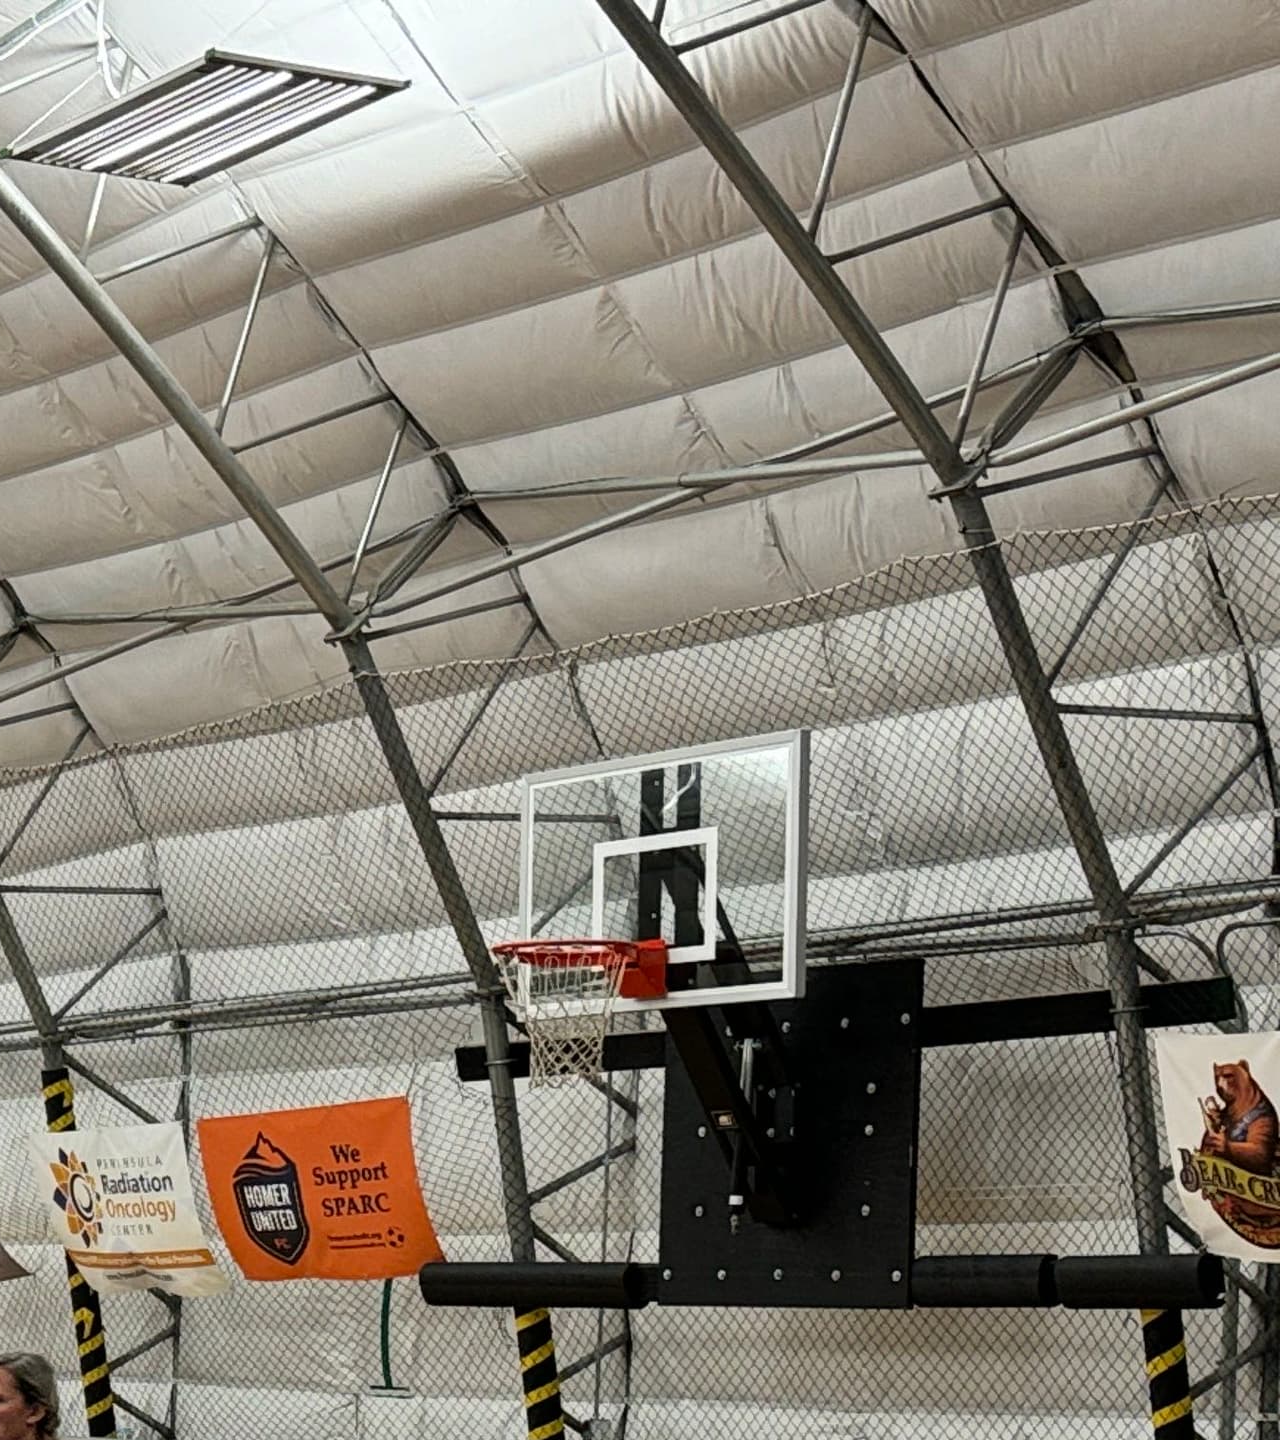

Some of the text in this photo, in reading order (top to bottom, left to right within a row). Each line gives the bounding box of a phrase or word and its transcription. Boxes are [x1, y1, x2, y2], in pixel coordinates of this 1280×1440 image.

[330, 1144, 361, 1163] We
[100, 1171, 174, 1195] Radiation
[312, 1162, 389, 1191] Support
[1177, 1148, 1243, 1194] BEAR
[243, 1183, 291, 1208] HOMER
[321, 1192, 391, 1217] SPARC
[105, 1196, 176, 1223] Oncology
[250, 1210, 298, 1232] UNITED
